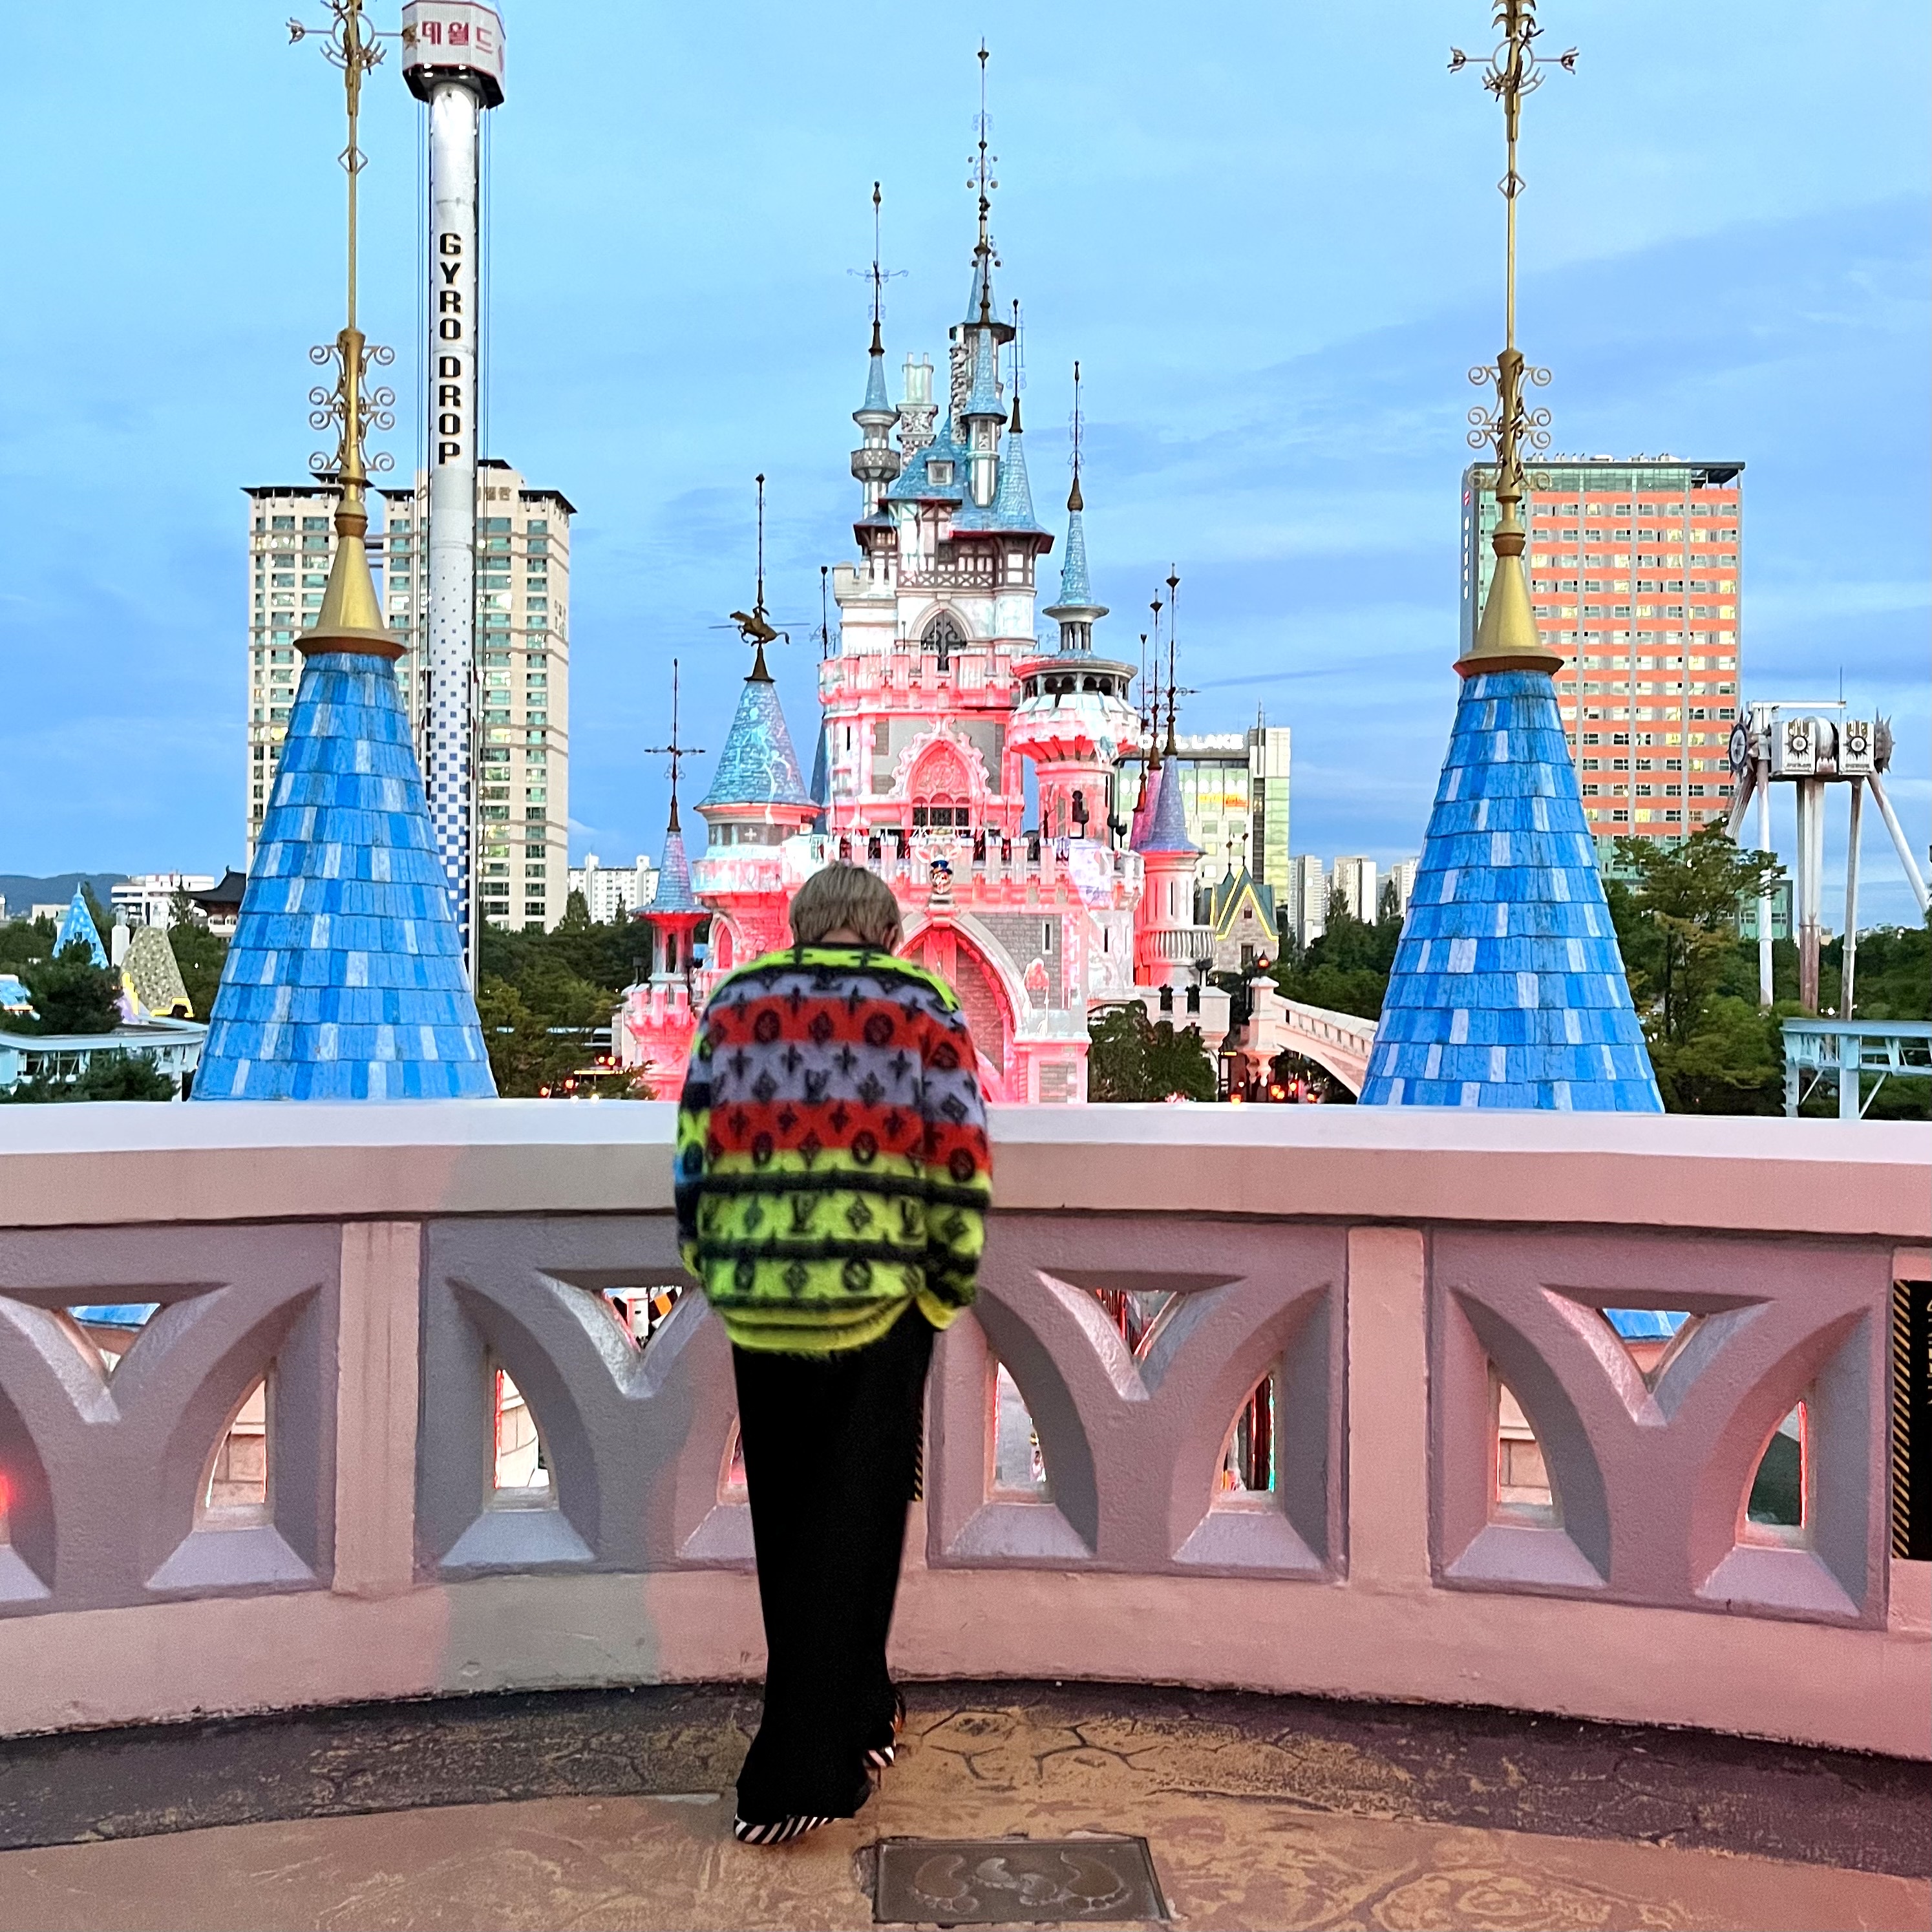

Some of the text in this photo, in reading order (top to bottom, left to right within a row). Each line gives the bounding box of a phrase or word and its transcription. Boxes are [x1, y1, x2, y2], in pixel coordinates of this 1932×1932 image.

[422, 21, 493, 54] 데월드
[438, 233, 462, 465] GYRO DROP
[1191, 734, 1244, 750] LAKE
